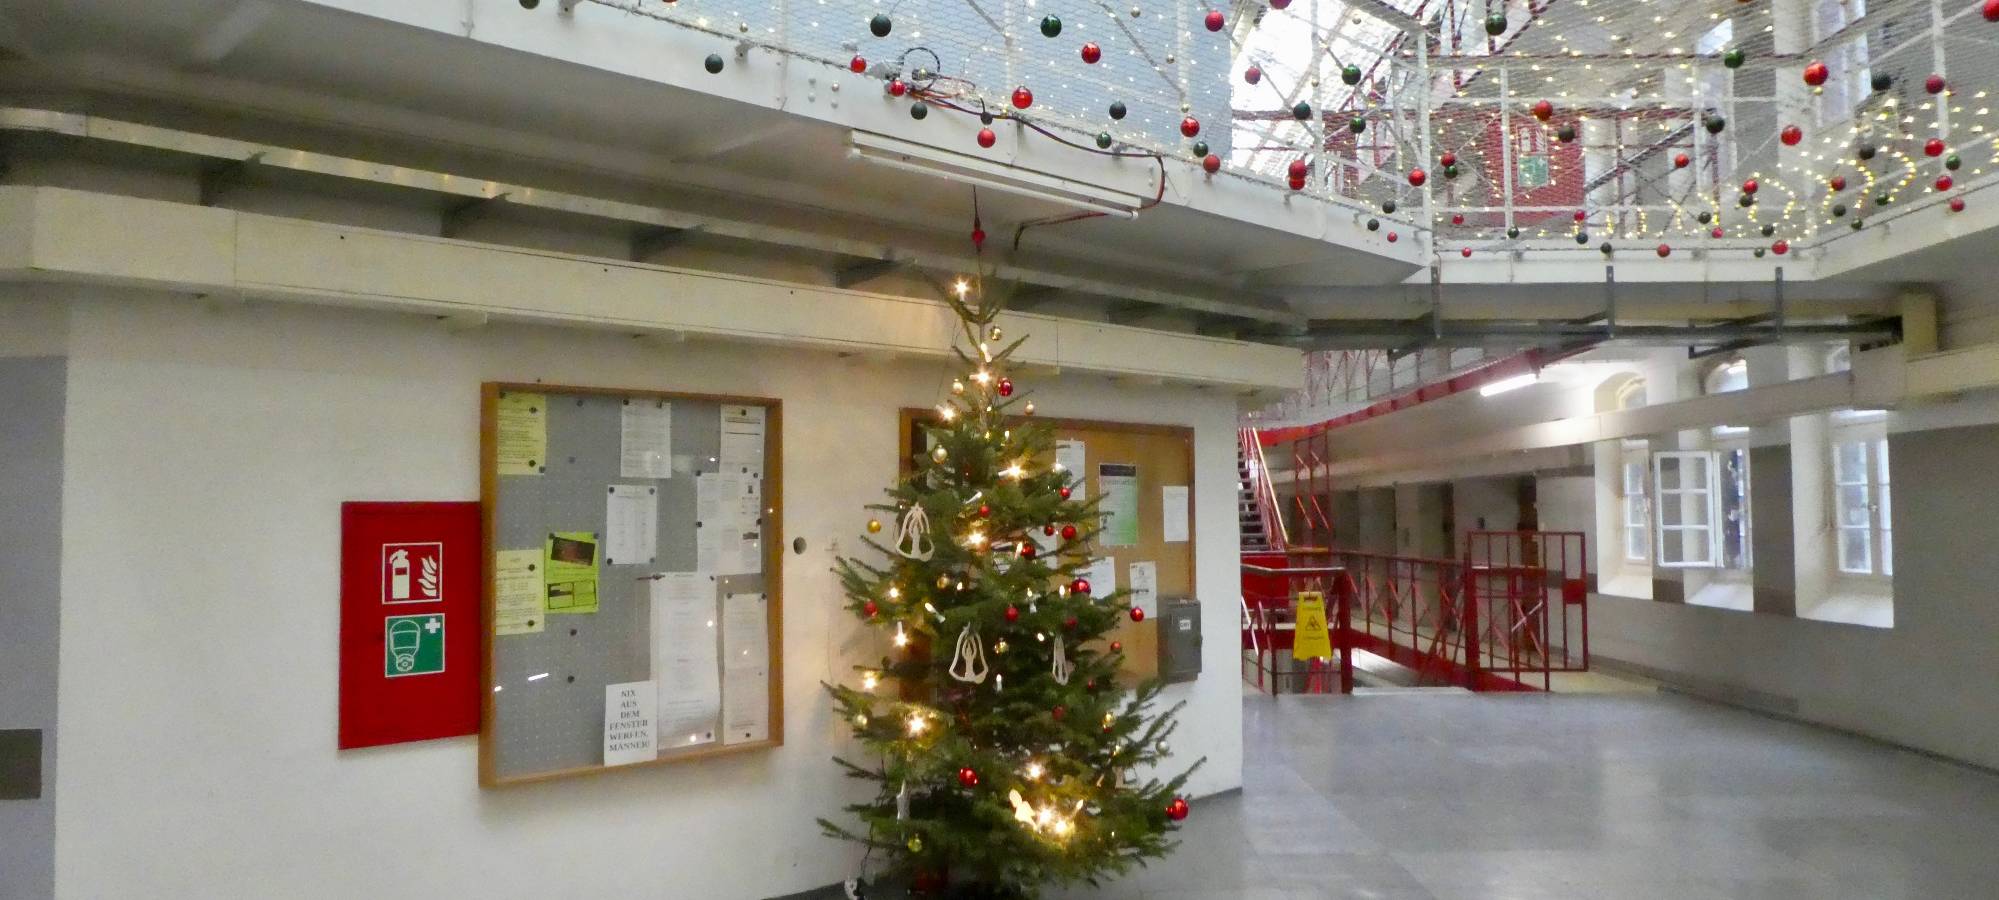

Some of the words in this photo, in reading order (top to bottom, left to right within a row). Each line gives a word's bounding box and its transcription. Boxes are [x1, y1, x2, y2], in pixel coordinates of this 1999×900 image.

[621, 700, 637, 708] AUS
[620, 711, 640, 719] DEM
[609, 720, 648, 730] FENSTER
